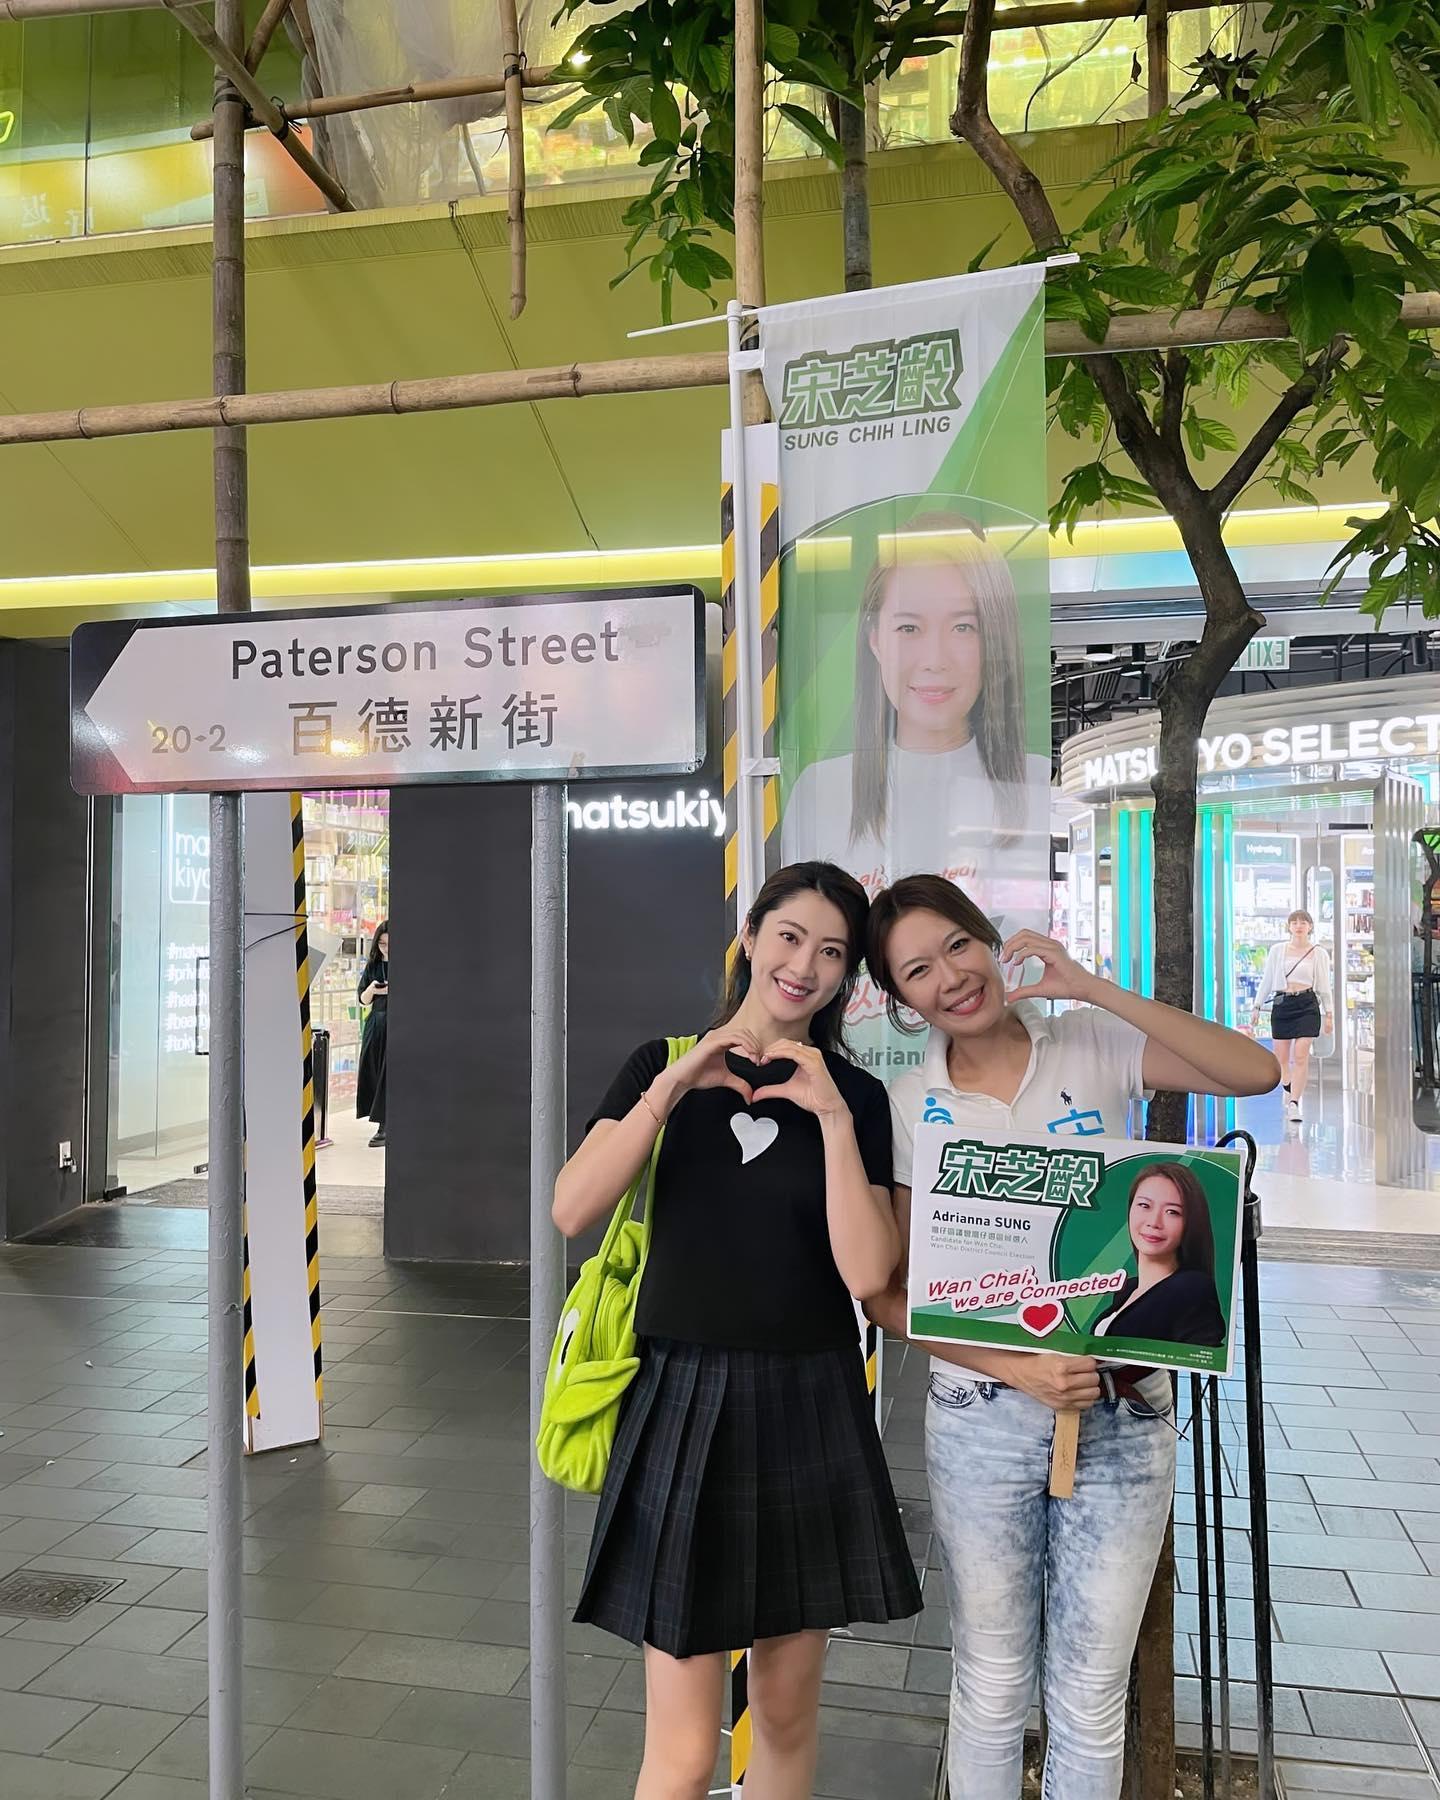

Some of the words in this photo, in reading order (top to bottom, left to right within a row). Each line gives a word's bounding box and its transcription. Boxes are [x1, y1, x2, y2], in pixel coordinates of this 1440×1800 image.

[781, 335, 958, 427] 宋芝齡
[784, 430, 839, 451] SUNG
[849, 423, 894, 443] CHIH
[902, 415, 950, 437] LING
[232, 637, 437, 680] Paterson
[463, 621, 619, 669] Street
[288, 691, 558, 756] 百德新街
[934, 1143, 1101, 1207] 宋芝齡
[932, 1210, 990, 1226] Adrianna
[995, 1217, 1031, 1231] SUNG
[929, 1280, 971, 1297] Wan
[980, 1269, 1033, 1289] Chai,
[955, 1296, 979, 1309] we
[985, 1291, 1014, 1306] are
[1020, 1274, 1122, 1300] Connected
